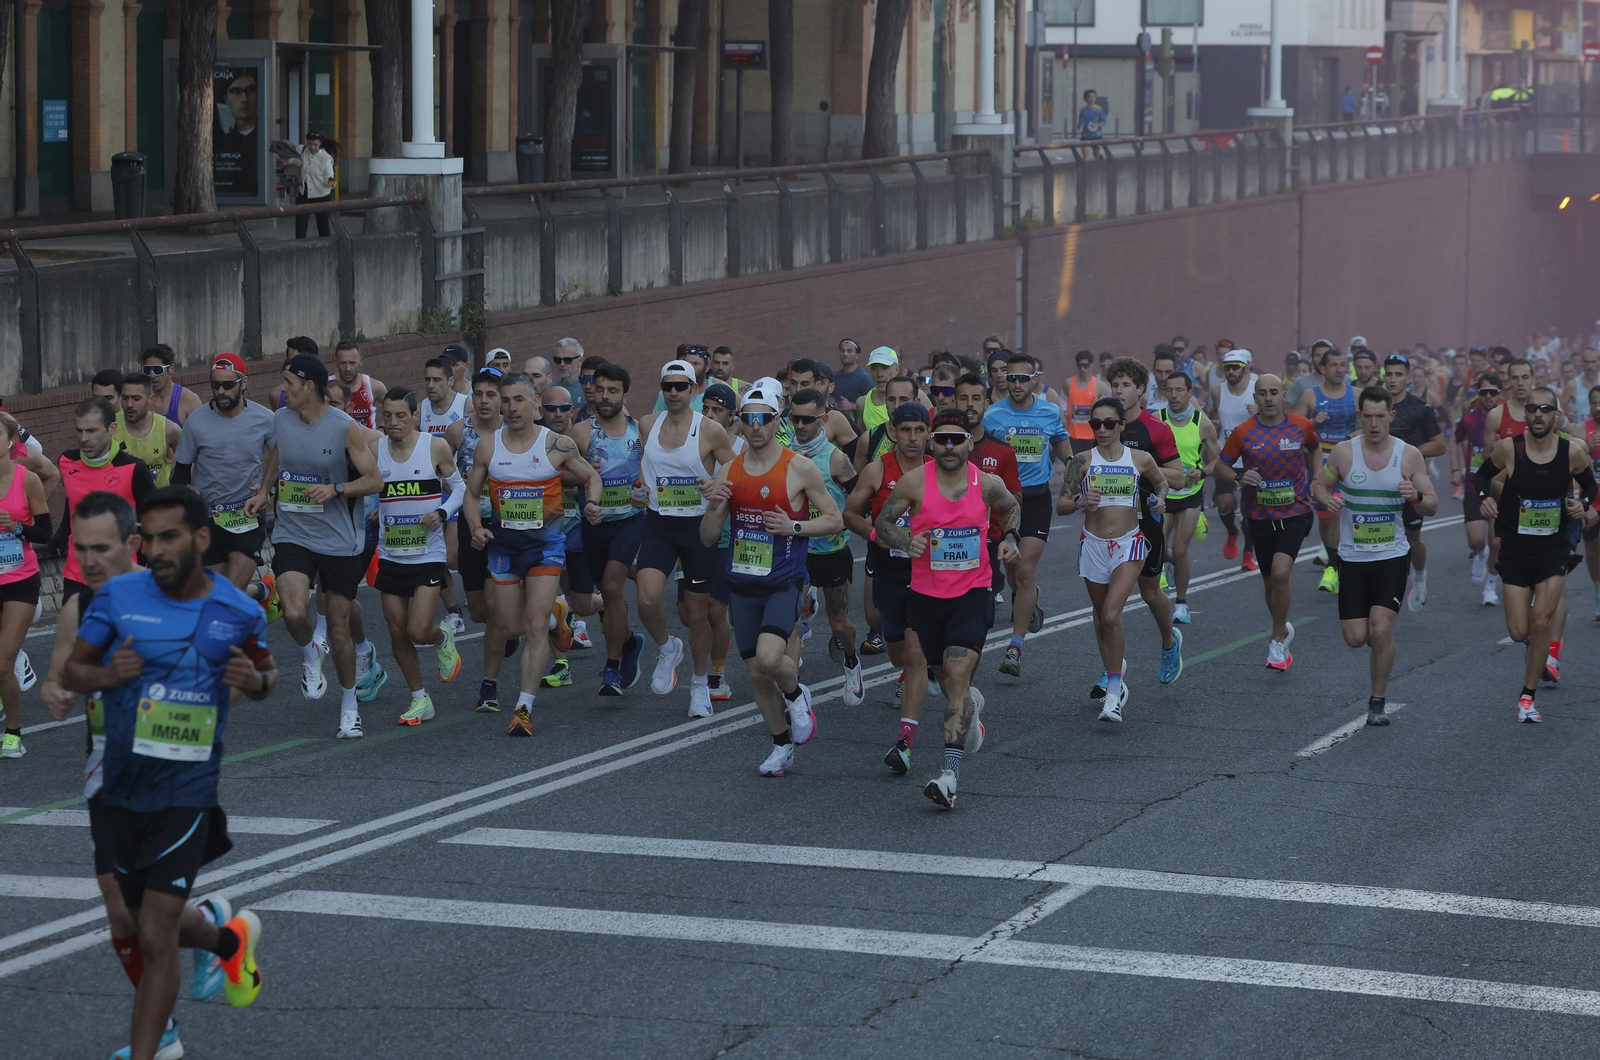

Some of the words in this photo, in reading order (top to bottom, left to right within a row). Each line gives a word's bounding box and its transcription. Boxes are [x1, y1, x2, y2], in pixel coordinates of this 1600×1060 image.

[1011, 446, 1037, 454] SMAEL
[387, 482, 420, 497] ASM
[1262, 497, 1291, 505] FIDELUS
[505, 511, 537, 520] TANQUE
[224, 517, 249, 527] JORGE
[1529, 519, 1551, 527] LARO
[745, 530, 768, 542] ZURICH
[948, 529, 976, 539] ZURICH
[385, 536, 427, 546] ANRECAFE
[949, 543, 963, 551] 5456
[738, 552, 762, 565] MARTÍ
[944, 552, 968, 562] FRAN
[169, 689, 211, 703] ZURICH
[151, 723, 201, 742] IMRAN
